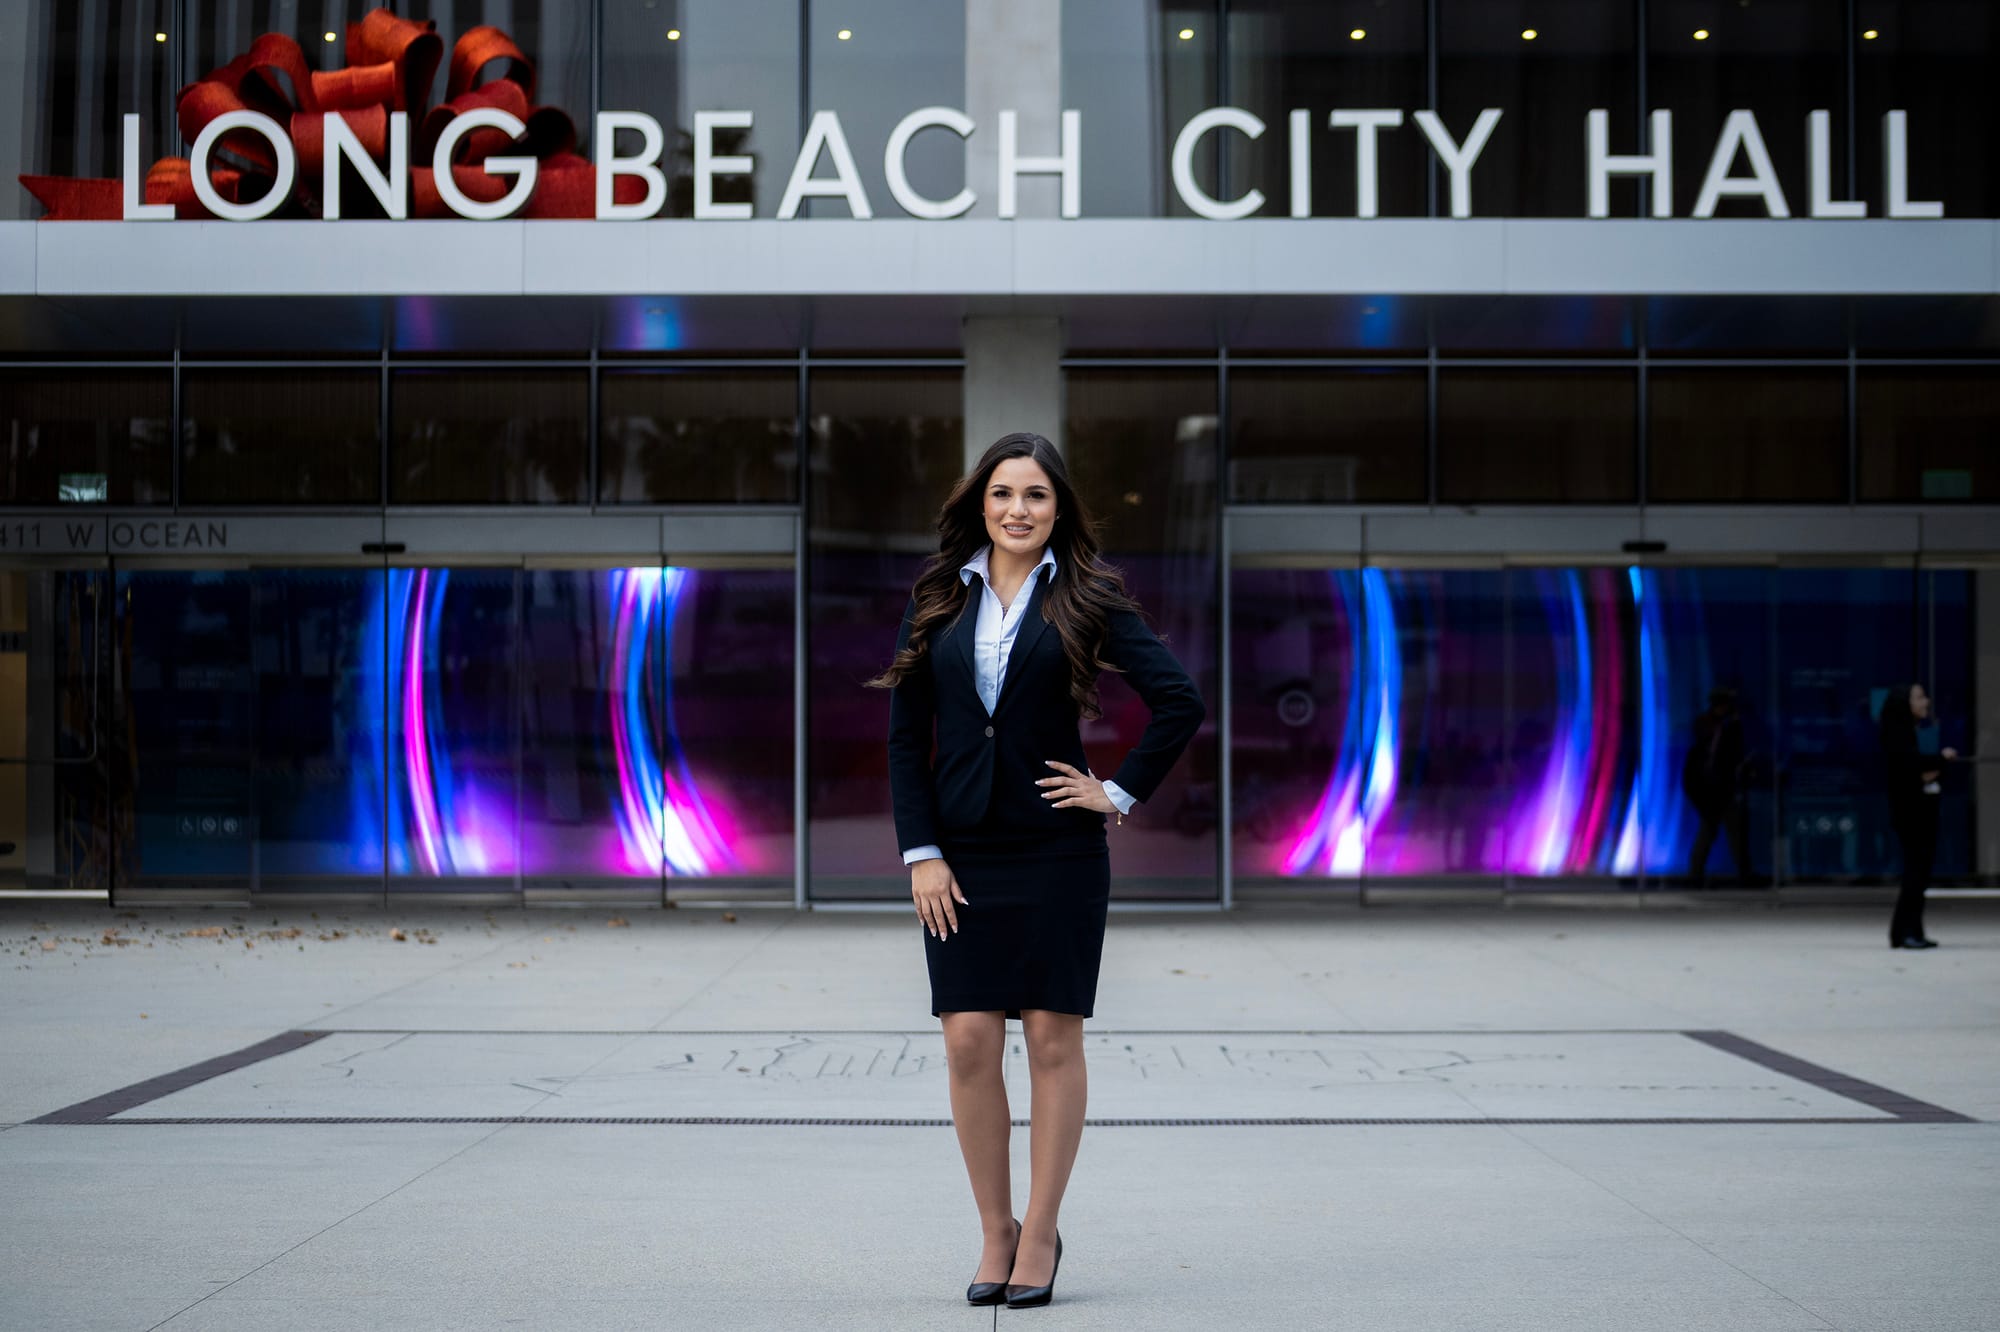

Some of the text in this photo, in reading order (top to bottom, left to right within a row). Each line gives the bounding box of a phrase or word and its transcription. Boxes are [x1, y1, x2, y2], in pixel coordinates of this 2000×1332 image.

[122, 107, 1945, 221] LONG BEACH CITY HALL
[66, 522, 95, 548] W
[111, 521, 228, 549] OCEAN
